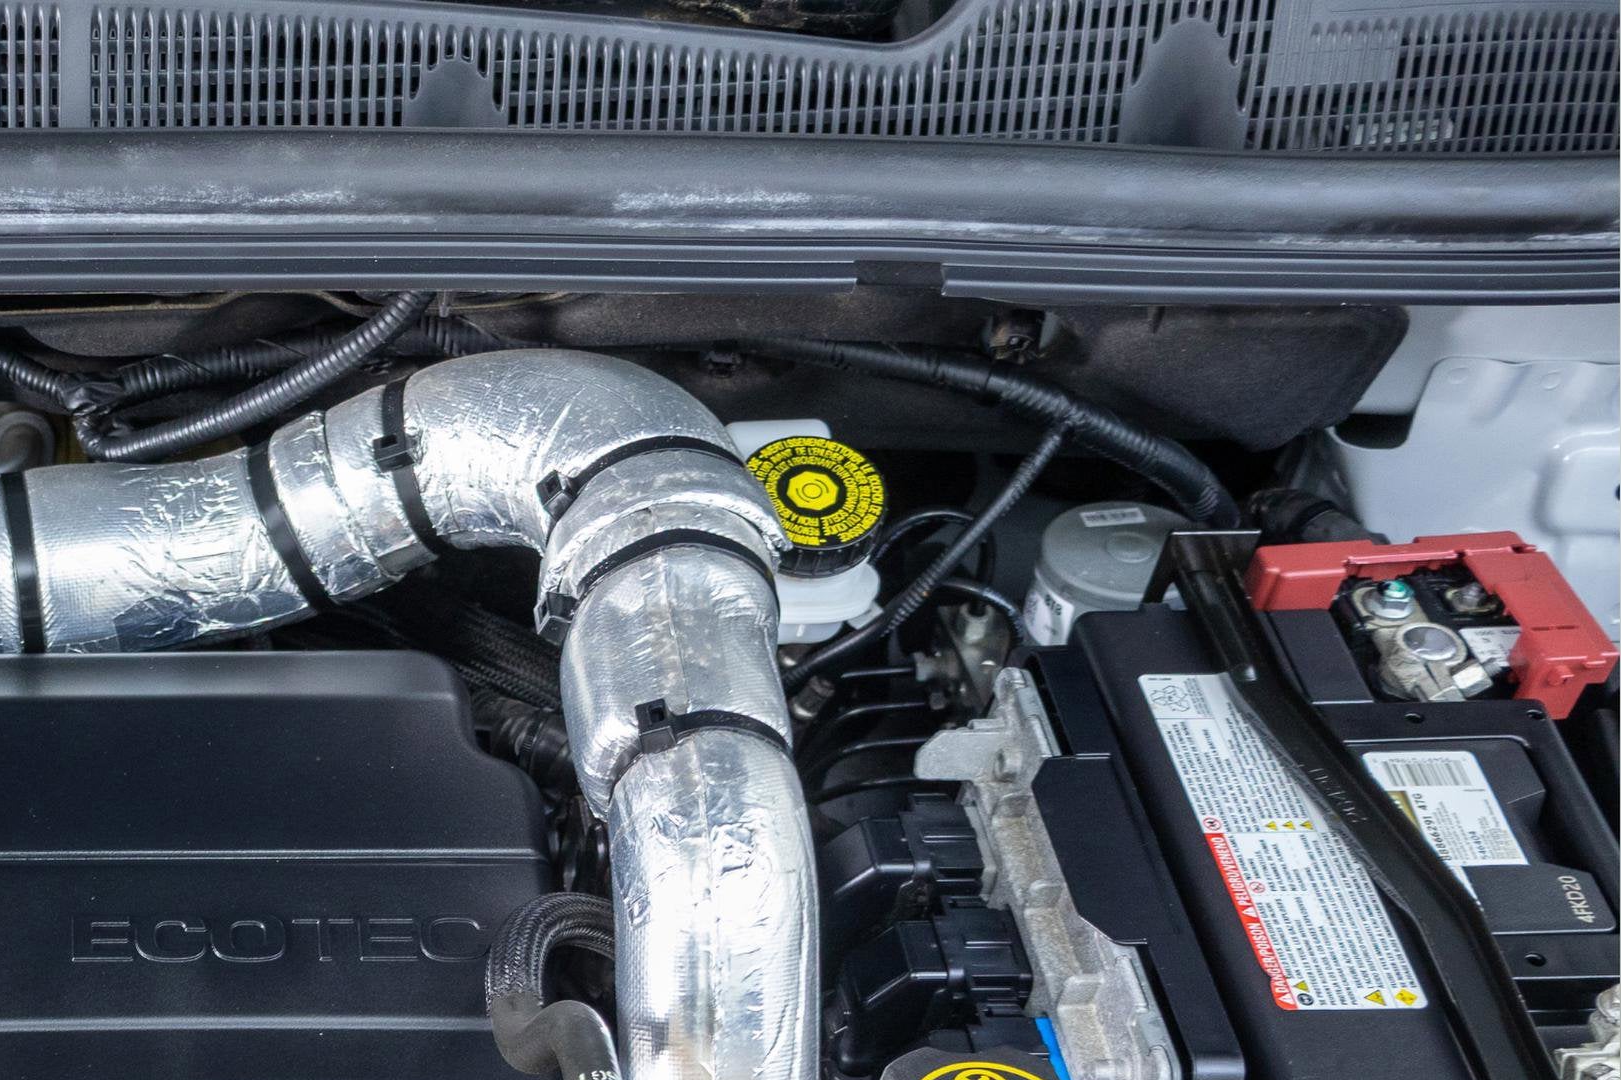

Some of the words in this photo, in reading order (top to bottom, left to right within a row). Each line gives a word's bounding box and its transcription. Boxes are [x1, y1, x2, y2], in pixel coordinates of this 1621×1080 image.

[1208, 837, 1252, 905] PELIGRO/VENENO
[1559, 876, 1593, 923] 4FKD20
[70, 915, 493, 963] ECOTEC
[1245, 922, 1290, 992] DANGER/POISON
